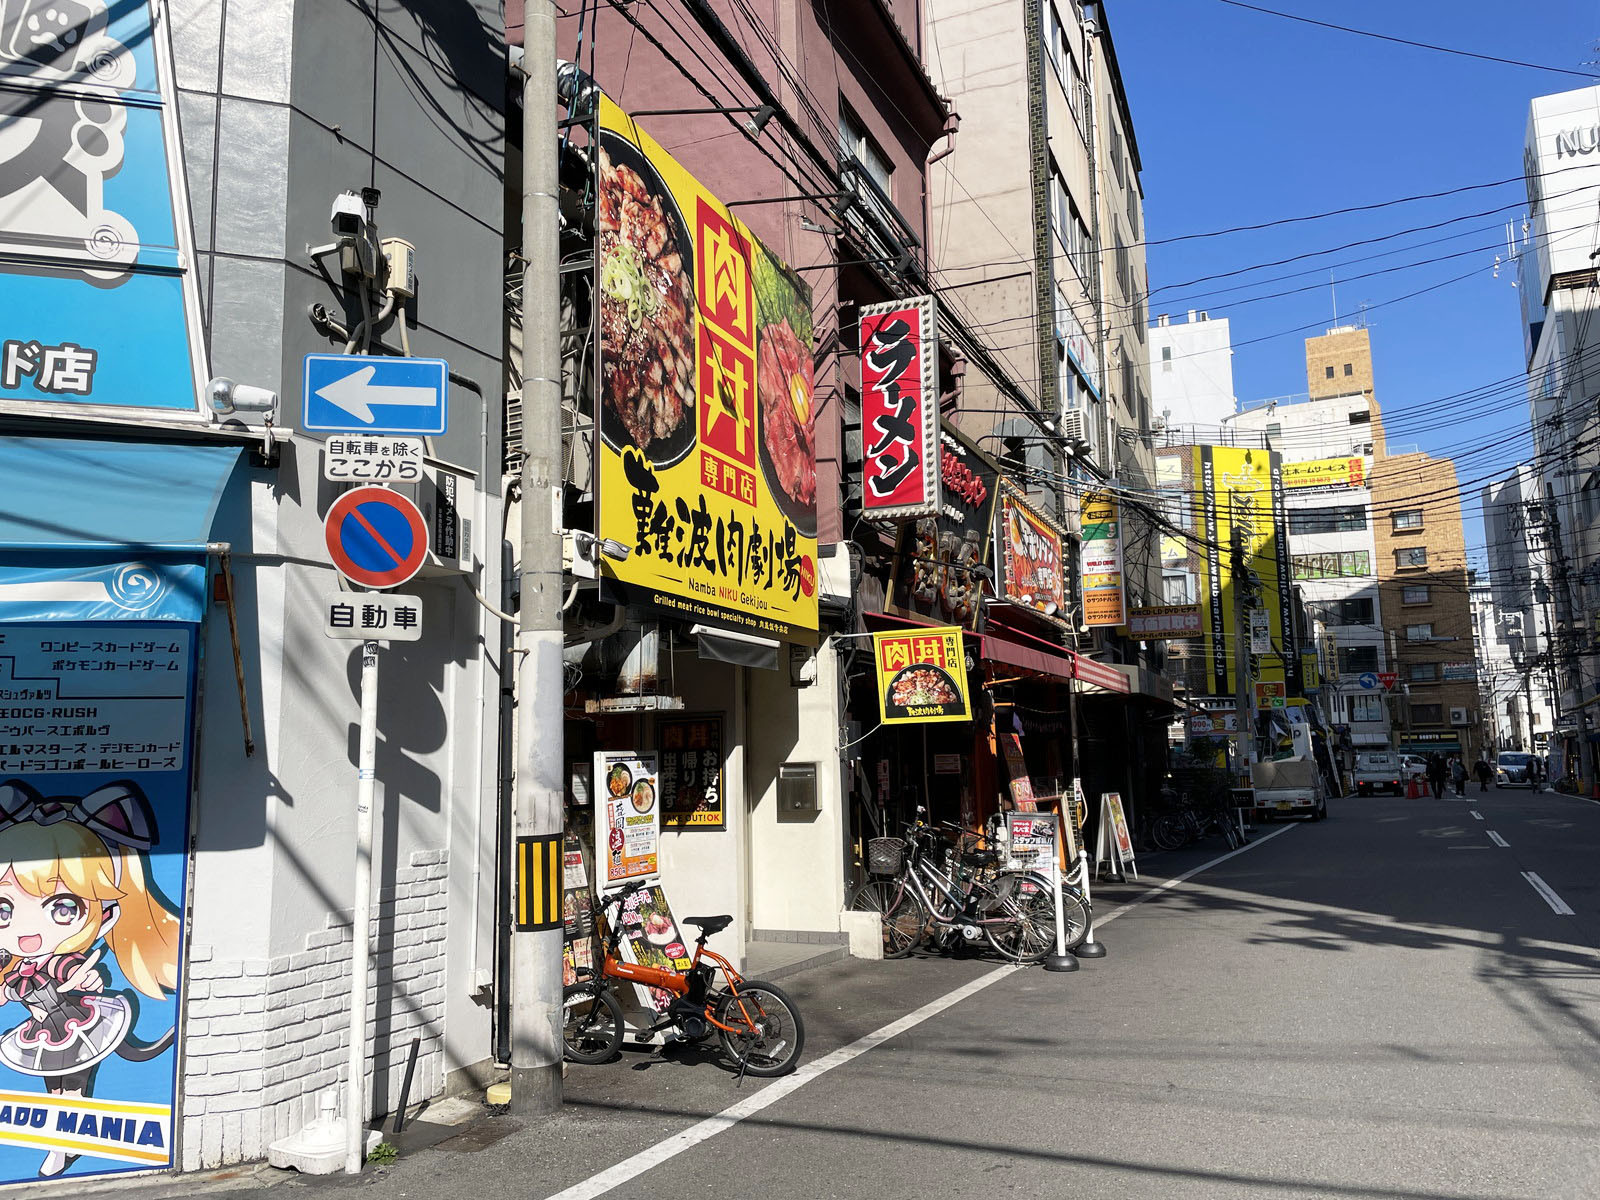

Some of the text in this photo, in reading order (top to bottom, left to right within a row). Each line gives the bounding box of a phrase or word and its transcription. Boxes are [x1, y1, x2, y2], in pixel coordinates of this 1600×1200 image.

[703, 223, 751, 457] 肉丼
[1, 342, 97, 393] ド店
[865, 319, 919, 498] ラーメン
[330, 440, 418, 457] 自転車を除く
[330, 459, 418, 479] ここから
[703, 456, 754, 504] 専門店
[445, 475, 455, 556] 防犯カメラ作動中
[623, 450, 802, 602] 難波肉劇場
[654, 594, 757, 627] Grilled meat rice bowl specialty shop
[688, 577, 768, 611] Namba NIKU Gekijou
[330, 602, 418, 631] 自動車
[41, 641, 180, 653] ワンピースカードゲーム
[52, 659, 179, 672] ポケモンカードゲーム
[884, 639, 943, 670] 肉丼
[945, 636, 958, 669] 専門店
[663, 752, 678, 809] 出来ます
[682, 751, 698, 788] 帰り
[702, 751, 718, 804] お持ち
[56, 1110, 164, 1148] MANIA
